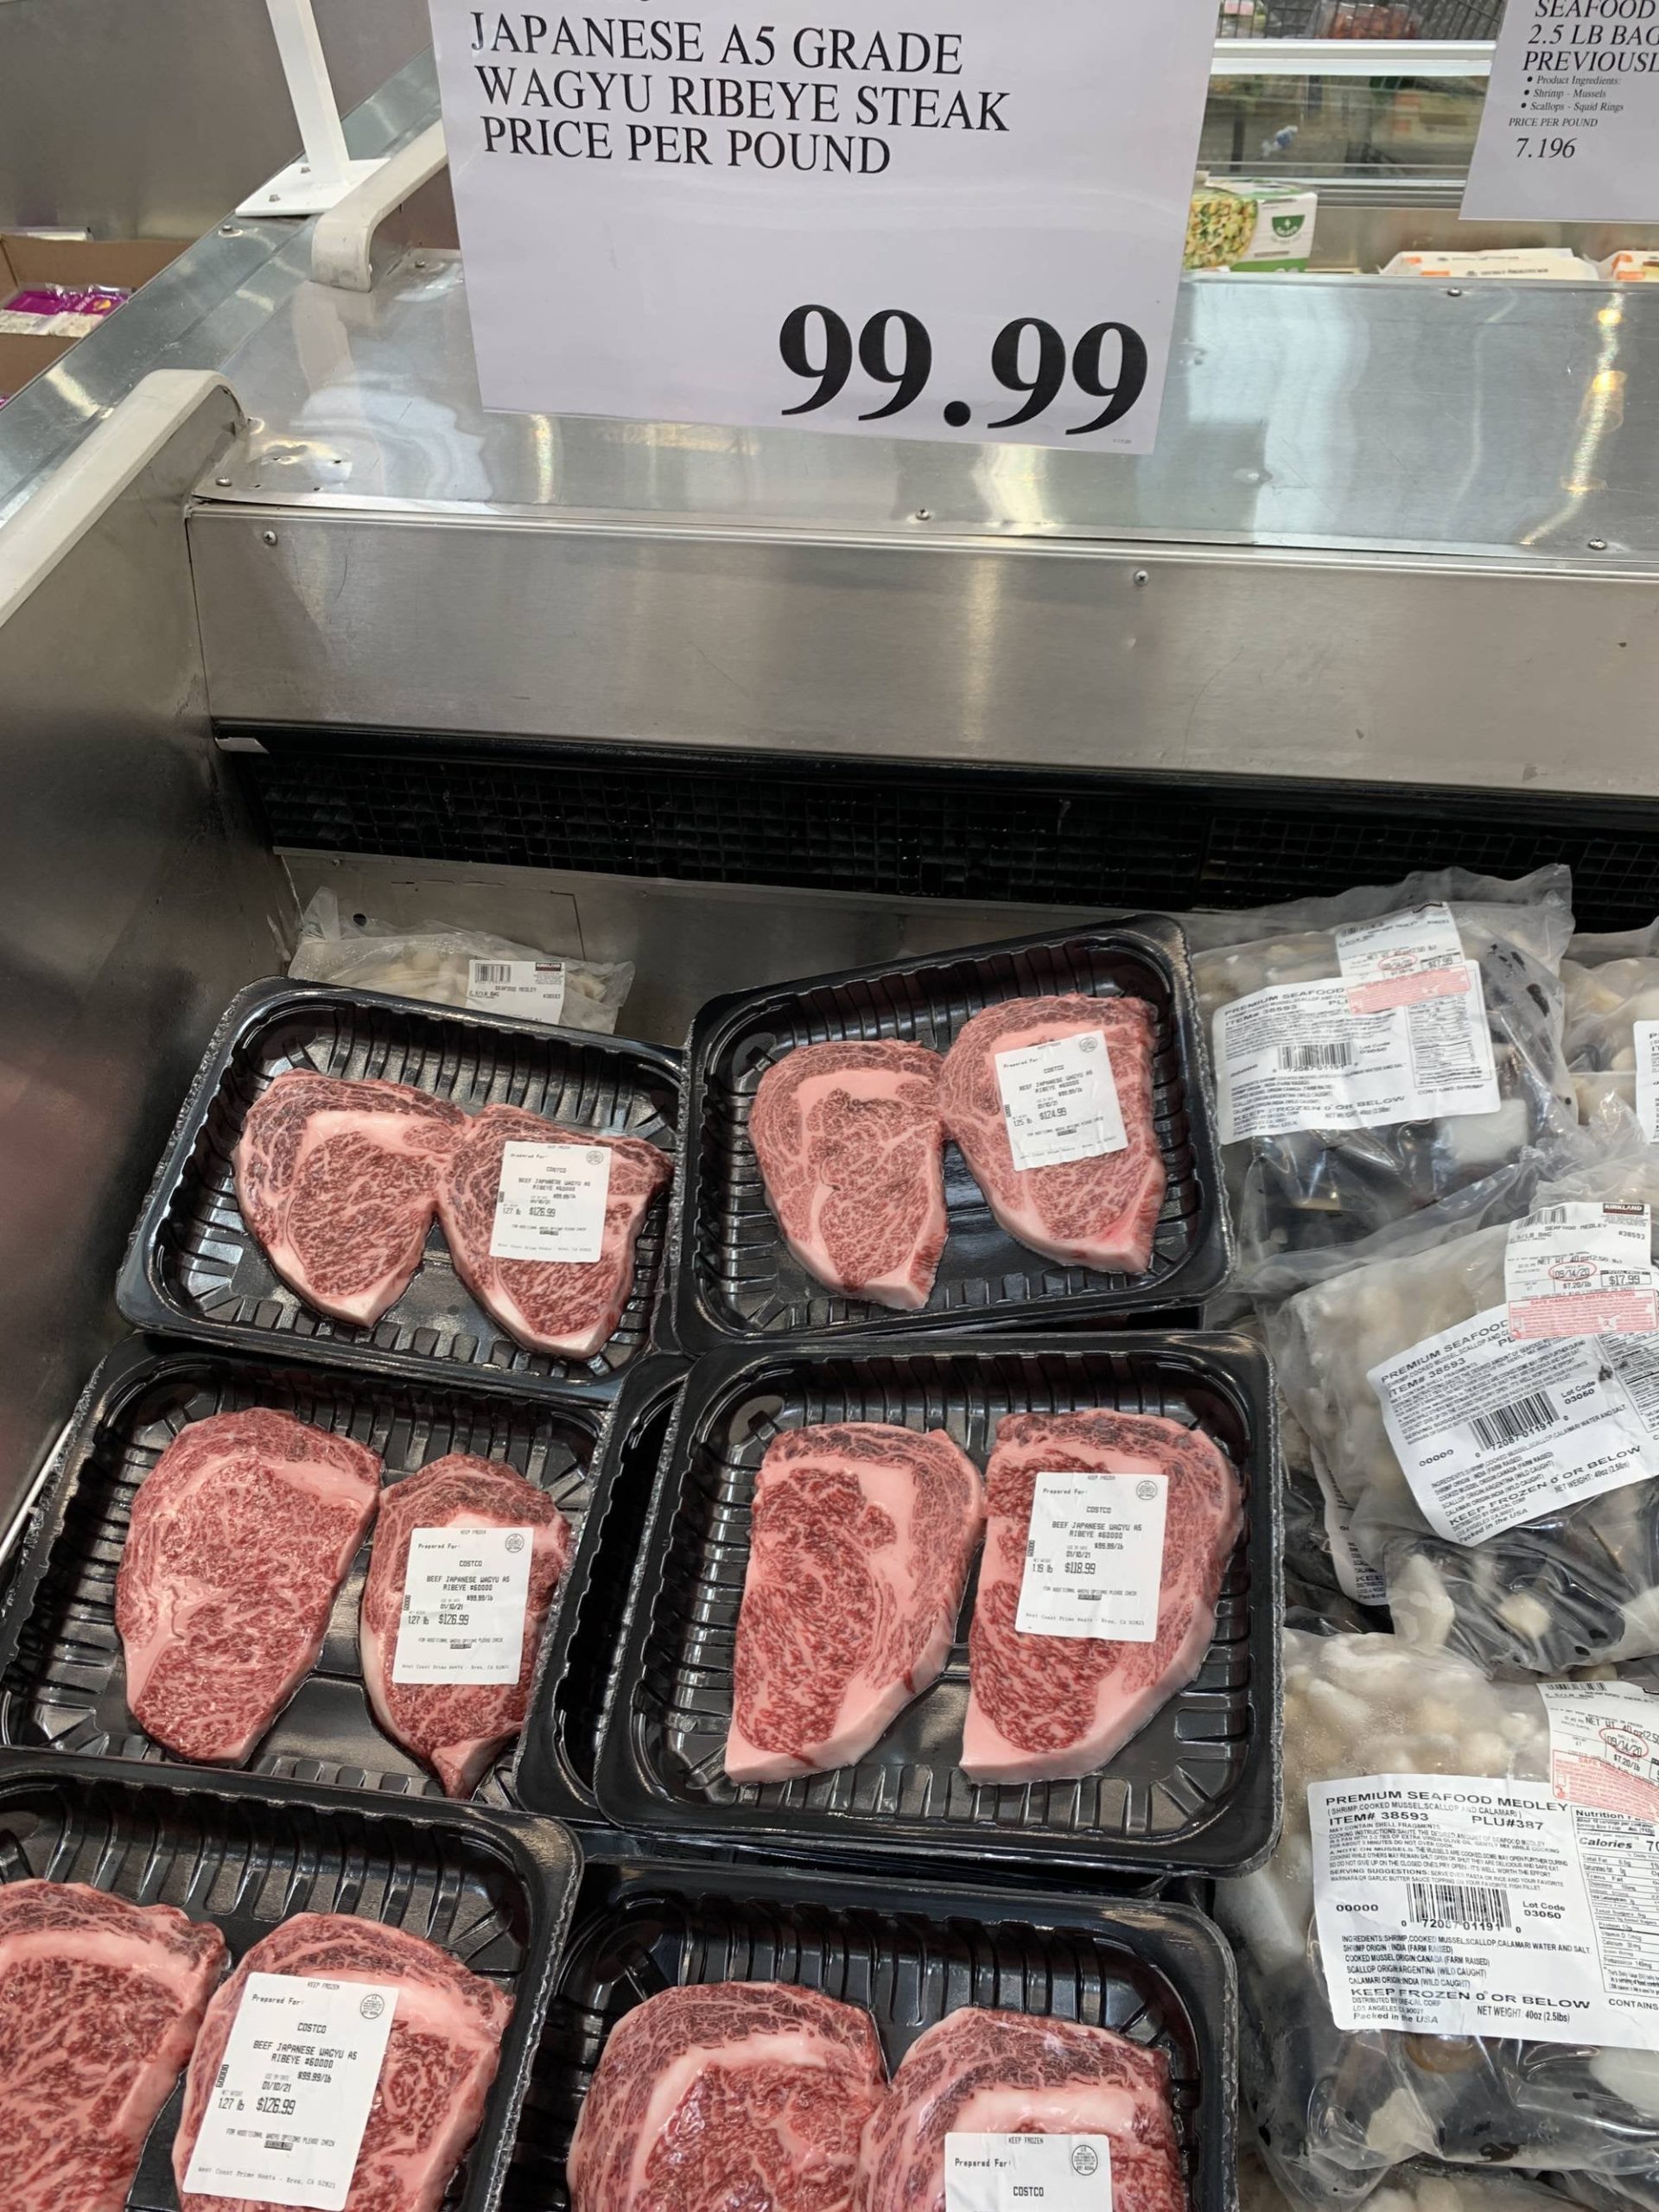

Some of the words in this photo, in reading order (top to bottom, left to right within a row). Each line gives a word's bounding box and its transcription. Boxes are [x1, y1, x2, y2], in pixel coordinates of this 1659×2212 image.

[1535, 0, 1656, 18] SEAFOOD
[1528, 24, 1564, 44] 2.5
[1570, 25, 1604, 44] LB
[469, 11, 705, 65] JAPANESE
[719, 26, 776, 67] A5
[792, 29, 964, 75] GRADE
[1536, 76, 1569, 85] Product
[1572, 76, 1621, 86] Ingredients:
[474, 66, 653, 114] WAGYU
[668, 77, 841, 124] RIBEYE
[855, 86, 1012, 133] STEAK
[1533, 89, 1564, 99] Shrimp
[1573, 89, 1606, 98] Mussels
[1530, 102, 1564, 112] Scallops
[1573, 102, 1598, 112] Squid
[1600, 103, 1624, 112] Rings
[1509, 118, 1538, 126] PRICE
[1540, 118, 1559, 126] PER
[1562, 118, 1598, 127] POUND
[480, 116, 614, 161] PRICE
[626, 124, 712, 167] PER
[725, 131, 892, 175] POUND
[1516, 137, 1577, 158] 7.196
[779, 302, 1149, 436] 99.99
[1224, 995, 1278, 1015] PREMIUM
[1282, 988, 1344, 999] SEAFOOD
[1357, 1096, 1406, 1108] BELOW
[1039, 1107, 1067, 1120] $124.99
[1609, 1275, 1641, 1286] $17.99
[1381, 1350, 1441, 1382] PREMIUM
[1429, 1357, 1465, 1378] 38593
[1560, 1389, 1574, 1398] Lot
[1575, 1381, 1596, 1393] Code
[1449, 1506, 1485, 1525] KEEP
[1490, 1482, 1548, 1508] FROZEN
[1562, 1467, 1584, 1479] OR
[1586, 1445, 1640, 1469] BELOW
[1510, 1509, 1528, 1519] USA
[1065, 1562, 1096, 1574] $118.99
[438, 1614, 469, 1625] $126.99
[1325, 1790, 1402, 1806] PREMIUM
[1407, 1790, 1492, 1804] SEAFOOD
[1497, 1797, 1568, 1811] MEDLEY
[1329, 1812, 1376, 1826] ITEM#
[1381, 1811, 1429, 1821] 38593
[1472, 1815, 1543, 1830] PLU#387
[1576, 1809, 1624, 1819] Nutrition
[1580, 1837, 1632, 1849] Calories
[1541, 1903, 1566, 1911] Code
[252, 1994, 284, 2005] Prepared
[1399, 1989, 1470, 2000] FROZEN
[1491, 1994, 1516, 2003] OR
[1522, 1996, 1590, 2009] BELOW
[1478, 2005, 1491, 2015] NET
[1526, 2010, 1541, 2020] 40oz
[1544, 2012, 1570, 2024] (2.5lbs)
[297, 2023, 327, 2034] COSTCO
[252, 2040, 273, 2050] BEEF
[276, 2042, 315, 2056] JAPANESE
[319, 2047, 344, 2059] WAGYU
[271, 2053, 302, 2065] RIBEYE
[304, 2056, 334, 2069] #60000
[297, 2071, 332, 2083] $99.99/lb
[262, 2081, 291, 2093] 01/10/21
[236, 2099, 245, 2111] lb
[256, 2097, 296, 2115] $126.99
[955, 2158, 990, 2167] Prepared
[1013, 2186, 1044, 2197] COSTCO
